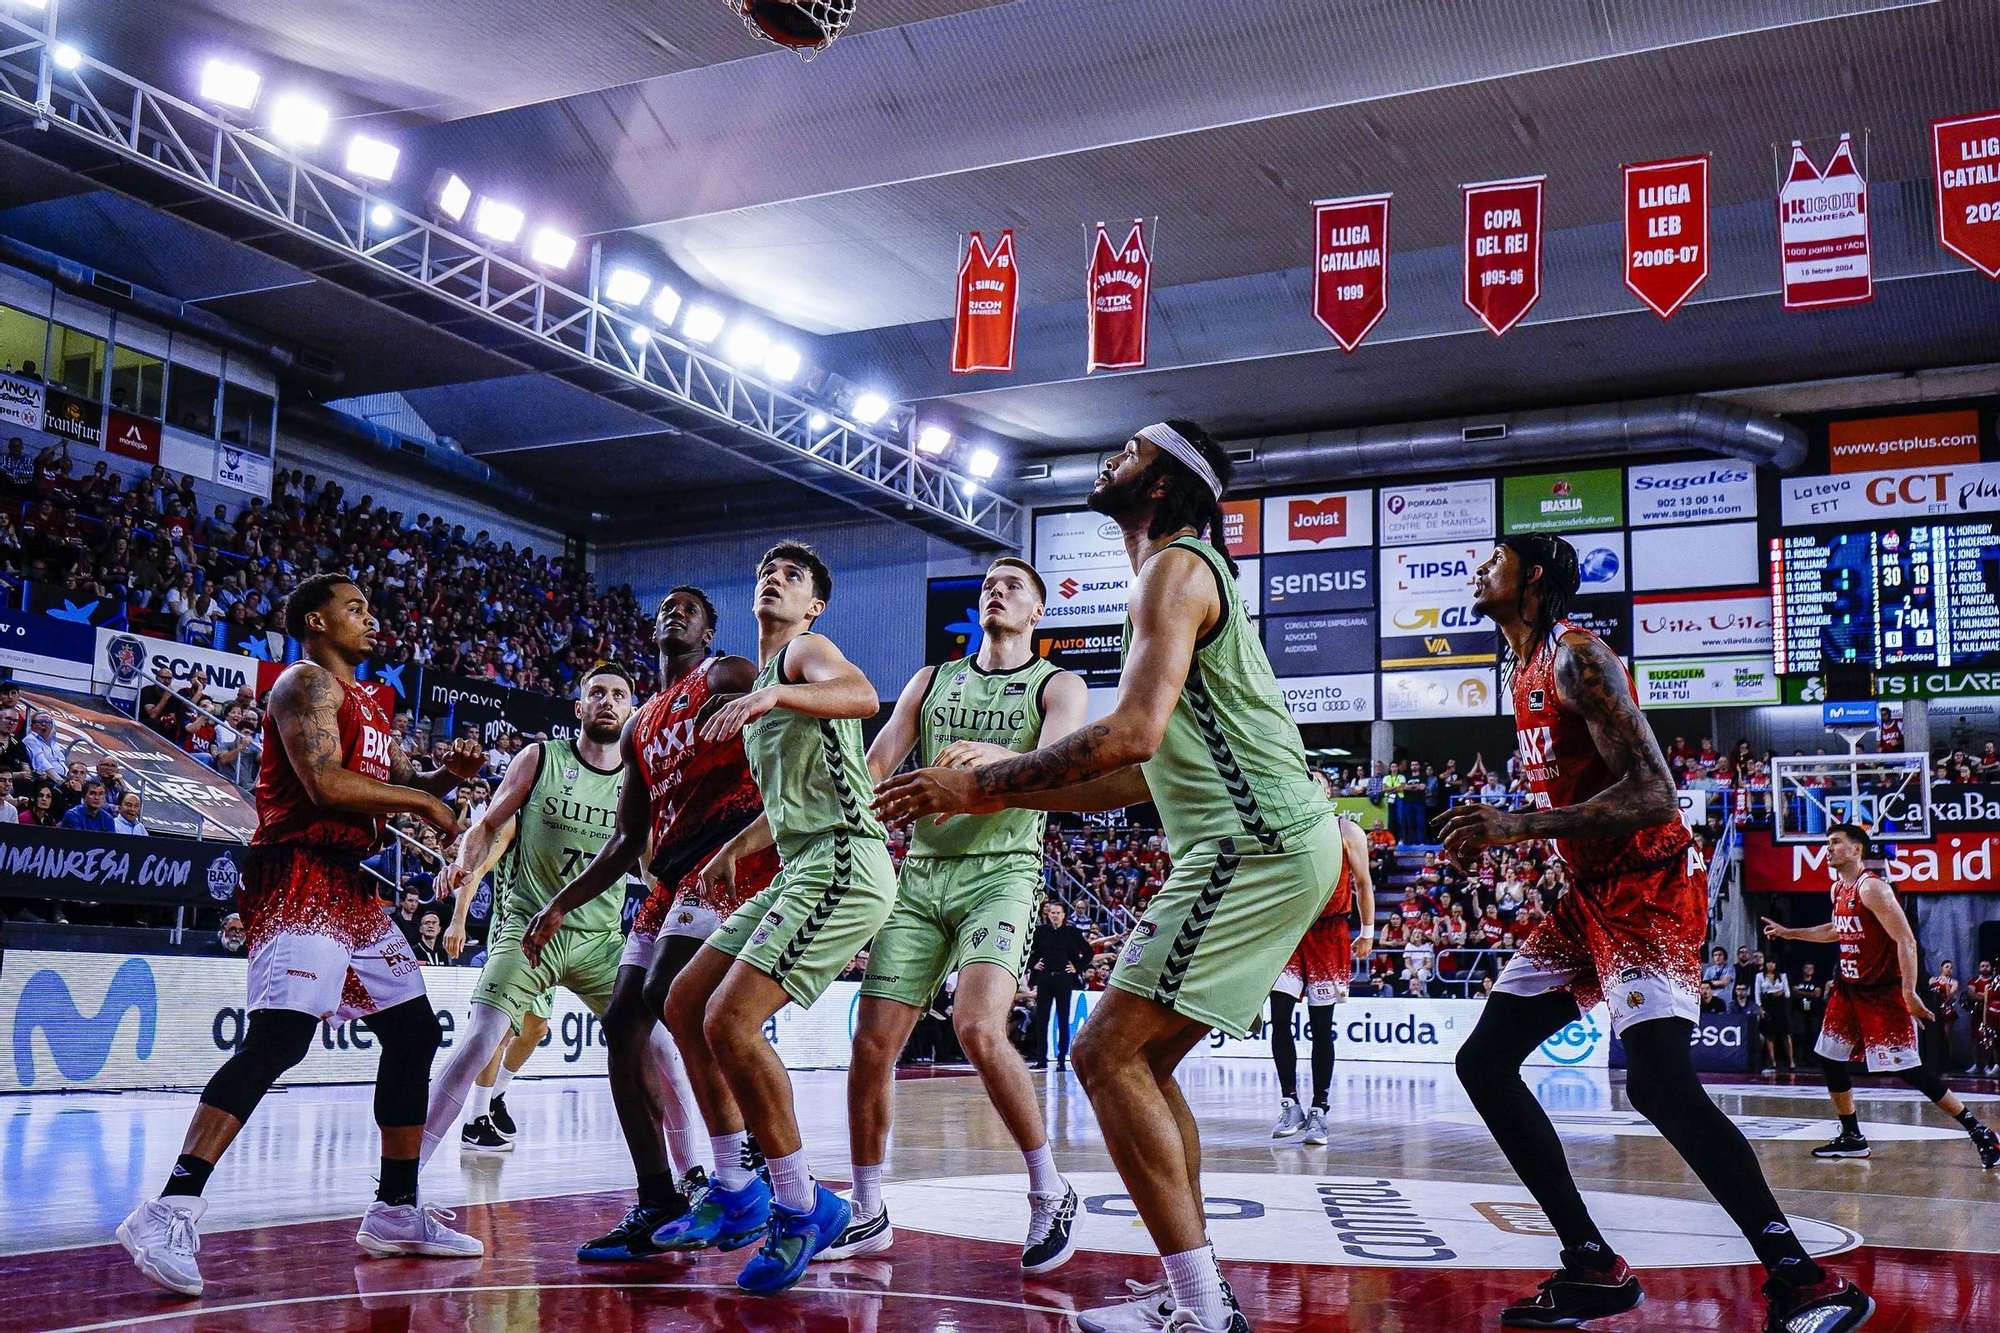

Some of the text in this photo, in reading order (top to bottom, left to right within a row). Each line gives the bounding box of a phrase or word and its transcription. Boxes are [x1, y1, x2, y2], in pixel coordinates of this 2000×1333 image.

[1943, 162, 2000, 189] CATAL
[1638, 183, 1691, 209] LLIGA
[1791, 192, 1856, 215] RICOH
[1484, 208, 1522, 230] COPA
[1791, 210, 1855, 224] MANRESA
[1648, 215, 1682, 238] LEB
[1331, 225, 1370, 247] LLIGA
[1476, 233, 1529, 257] DEL REI
[1786, 248, 1806, 256] 1000
[1808, 245, 1834, 256] partits
[997, 254, 1009, 268] 15
[1125, 249, 1140, 264] 10
[1321, 249, 1380, 273] CATALANA
[1633, 246, 1699, 268] 2006-07
[1480, 268, 1523, 288] 1995-96
[1811, 267, 1833, 275] febrer
[1107, 294, 1132, 306] TDK
[1337, 284, 1364, 301] 1999
[968, 300, 1002, 309] RICOH
[1097, 305, 1132, 313] MANRESA
[44, 409, 101, 442] frankfurt
[118, 437, 148, 451] montepio
[1833, 432, 1977, 457] www.gctplus.com
[219, 469, 243, 484] CEM
[1634, 468, 1748, 491] Sagalés
[1794, 479, 1851, 500] La teva
[1866, 472, 1953, 506] GCT
[1958, 476, 2000, 511] plu
[1540, 498, 1583, 513] BRASILIA
[1657, 494, 1726, 508] 902 13 00 14
[1811, 499, 1840, 515] ETT
[1928, 503, 1949, 514] ETT
[1293, 511, 1340, 529] Joviat
[1642, 504, 1742, 520] www.sagales.com
[1049, 549, 1126, 561] FULL TRACTIO
[1957, 547, 1980, 559] JONES
[1407, 560, 1468, 579] TIPSA
[1883, 566, 1901, 587] 30
[1913, 564, 1929, 585] 19
[1958, 571, 1982, 583] REYES
[1082, 580, 1128, 592] SUZUKI
[1270, 569, 1367, 596] sensus
[1903, 595, 1911, 609] 2
[1044, 604, 1096, 617] CCESSORIS
[1894, 608, 1929, 629] 7:04
[1053, 635, 1123, 649] AUTOKOLEC
[151, 654, 247, 691] SCANIA
[1648, 668, 1705, 681] BUSQUEM
[1649, 680, 1689, 691] TALENT
[1736, 680, 1763, 688] ROOM
[1650, 691, 1669, 700] PER
[932, 705, 1025, 731] surne
[552, 724, 571, 740] CAL
[642, 718, 695, 767] AXI
[1516, 725, 1556, 766] AXI
[541, 819, 579, 836] seguros
[208, 869, 238, 884] BAXI
[1137, 924, 1152, 934] acb
[874, 975, 897, 984] CORREO
[1622, 973, 1638, 982] acb
[1346, 1013, 1439, 1045] ciuda
[1314, 1179, 1459, 1262] CONTROL
